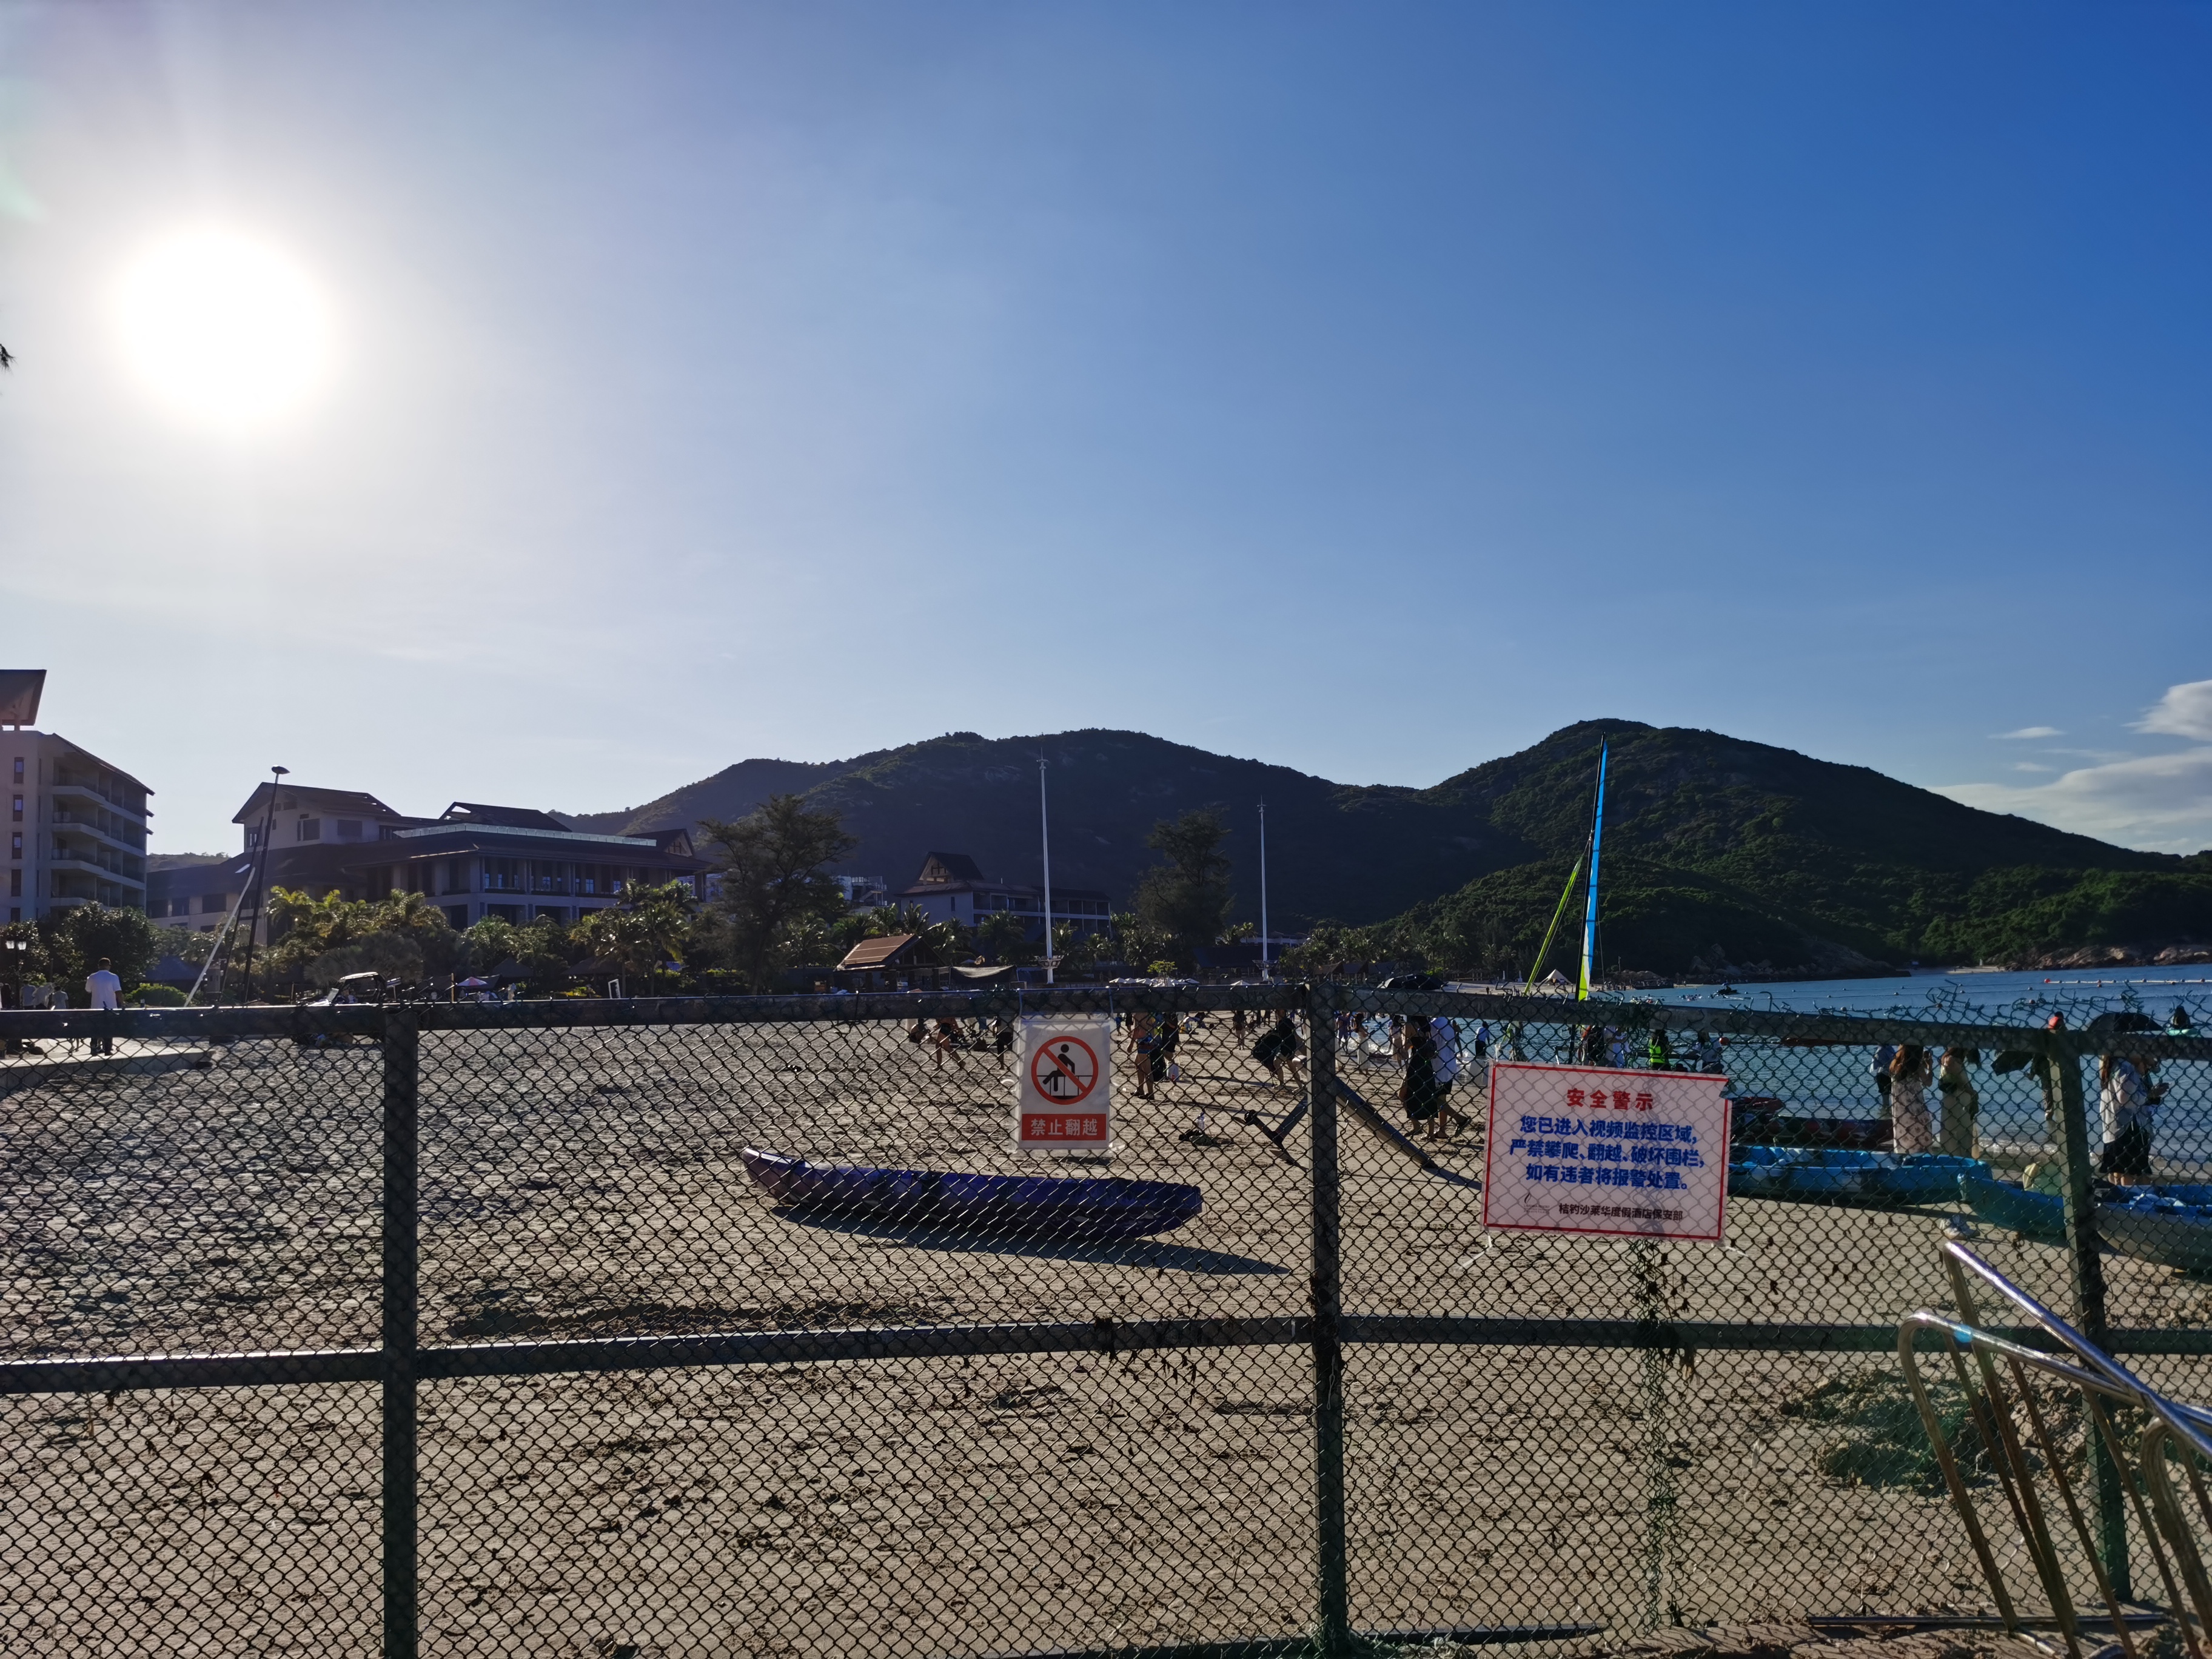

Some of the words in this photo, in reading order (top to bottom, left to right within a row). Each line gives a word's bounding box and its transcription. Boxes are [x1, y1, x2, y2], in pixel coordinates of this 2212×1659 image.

[1566, 1088, 1654, 1111] 安全警示
[1031, 1119, 1098, 1136] 禁止翻越
[1520, 1115, 1697, 1144] 您已进入视频监控区域，
[1526, 1163, 1687, 1190] 如有违者将报警处置。
[1558, 1203, 1683, 1221] 桔钓沙莱华度假酒店保安部
